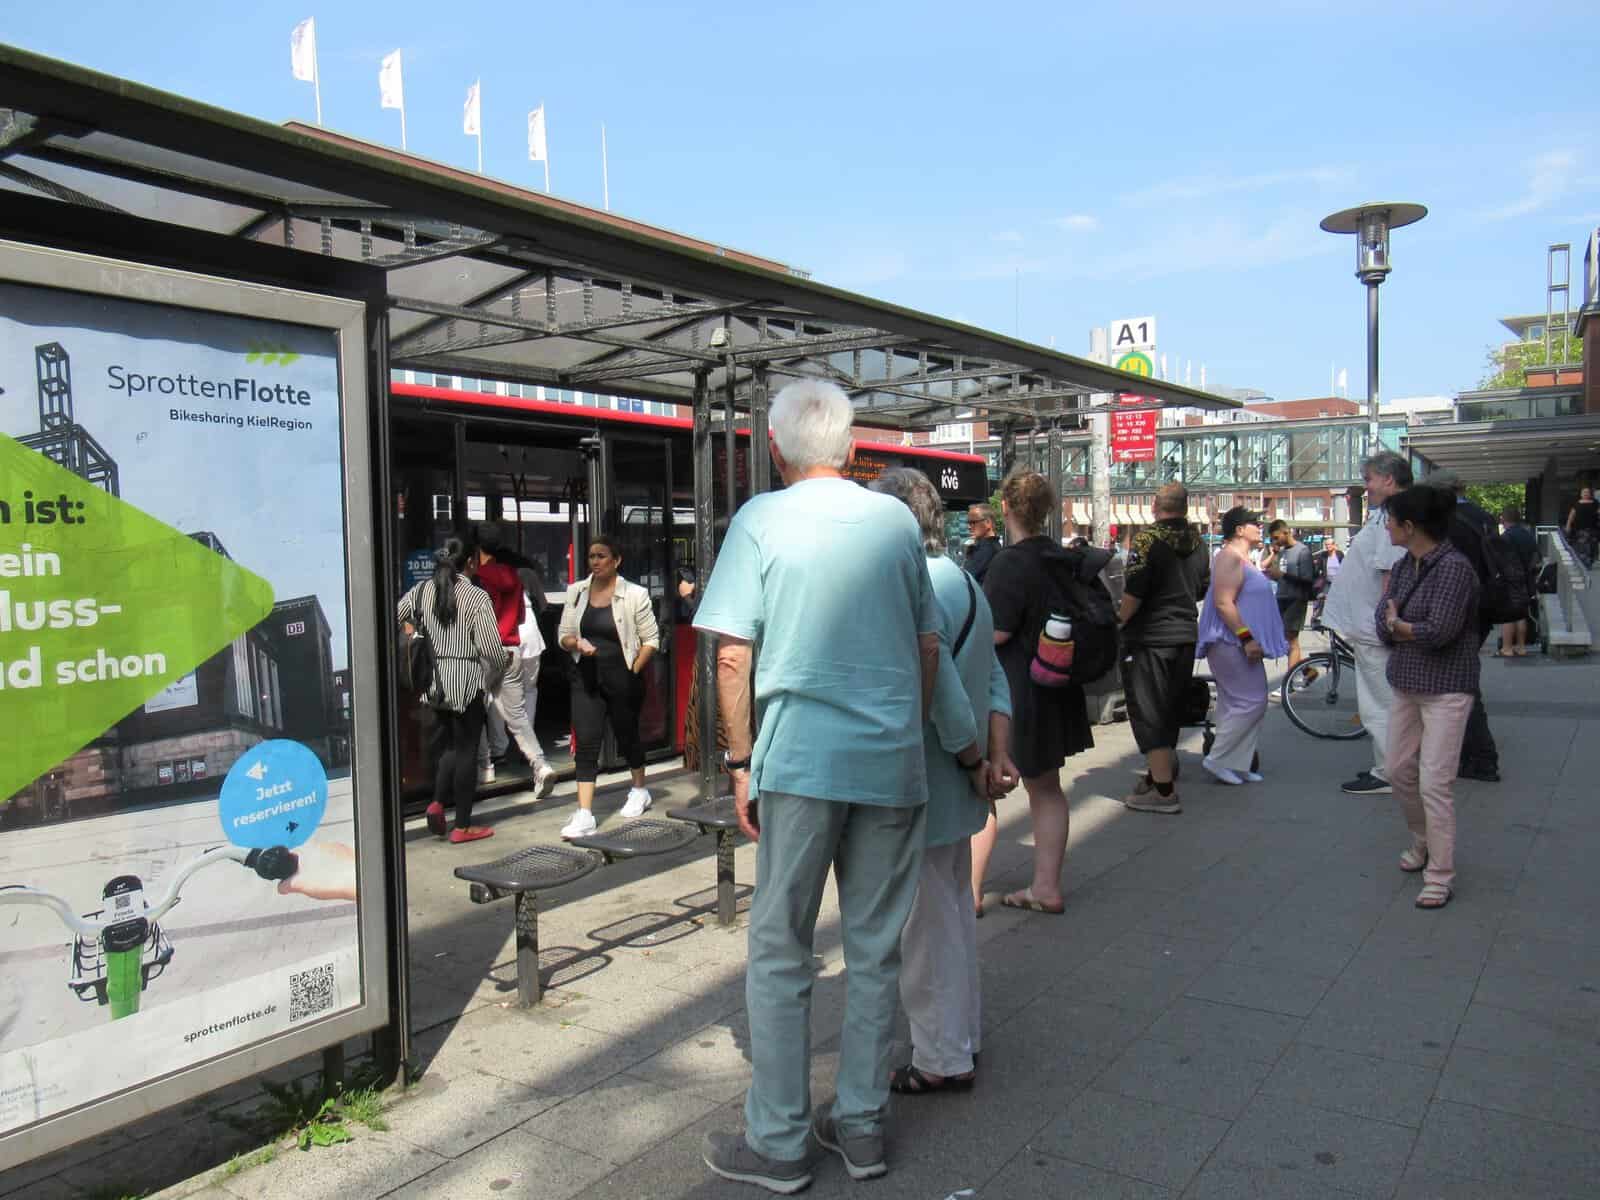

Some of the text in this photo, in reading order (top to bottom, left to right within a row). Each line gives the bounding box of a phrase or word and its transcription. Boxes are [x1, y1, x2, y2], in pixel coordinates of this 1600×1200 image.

[1116, 321, 1148, 346] A1
[107, 365, 311, 406] SprottenFlotte
[169, 409, 312, 432] Bikesharing KielRegion
[941, 474, 959, 490] KVG
[24, 491, 86, 525] ist:
[287, 622, 304, 635] DB
[56, 648, 167, 685] schon
[256, 780, 293, 801] Jetzt
[233, 791, 318, 828] reservieren!
[184, 1004, 278, 1043] sprottenflotte.de
